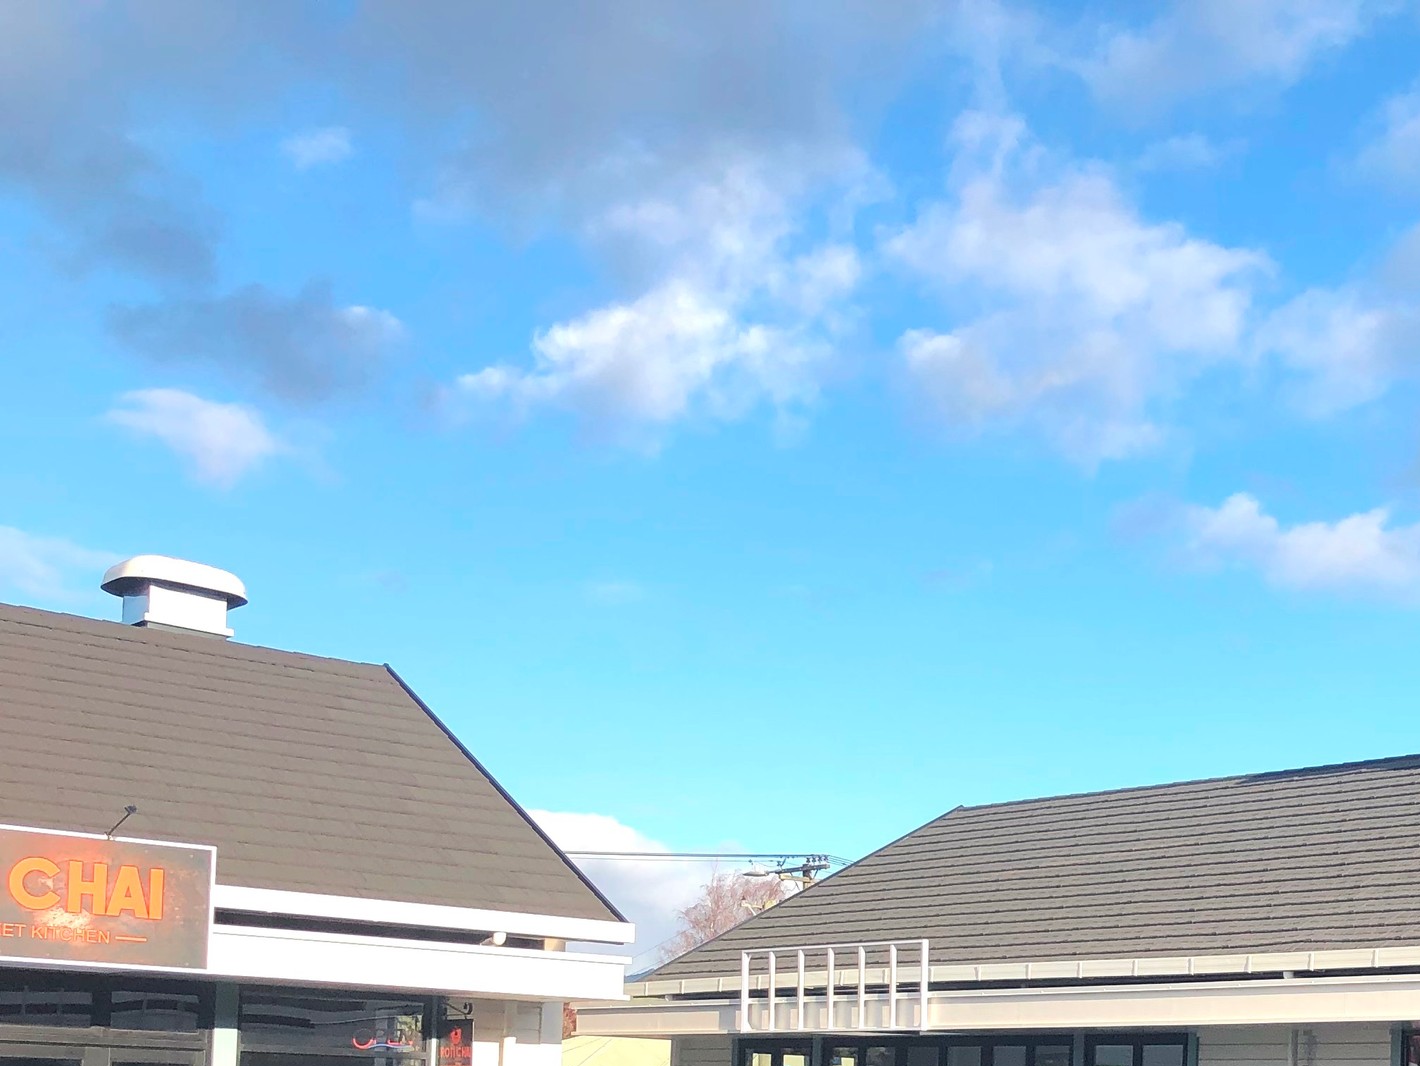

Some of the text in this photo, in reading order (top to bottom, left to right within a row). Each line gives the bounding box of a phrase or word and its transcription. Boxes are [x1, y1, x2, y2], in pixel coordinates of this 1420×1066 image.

[9, 856, 165, 920] CHAI
[0, 923, 111, 945] ET KITCHEN
